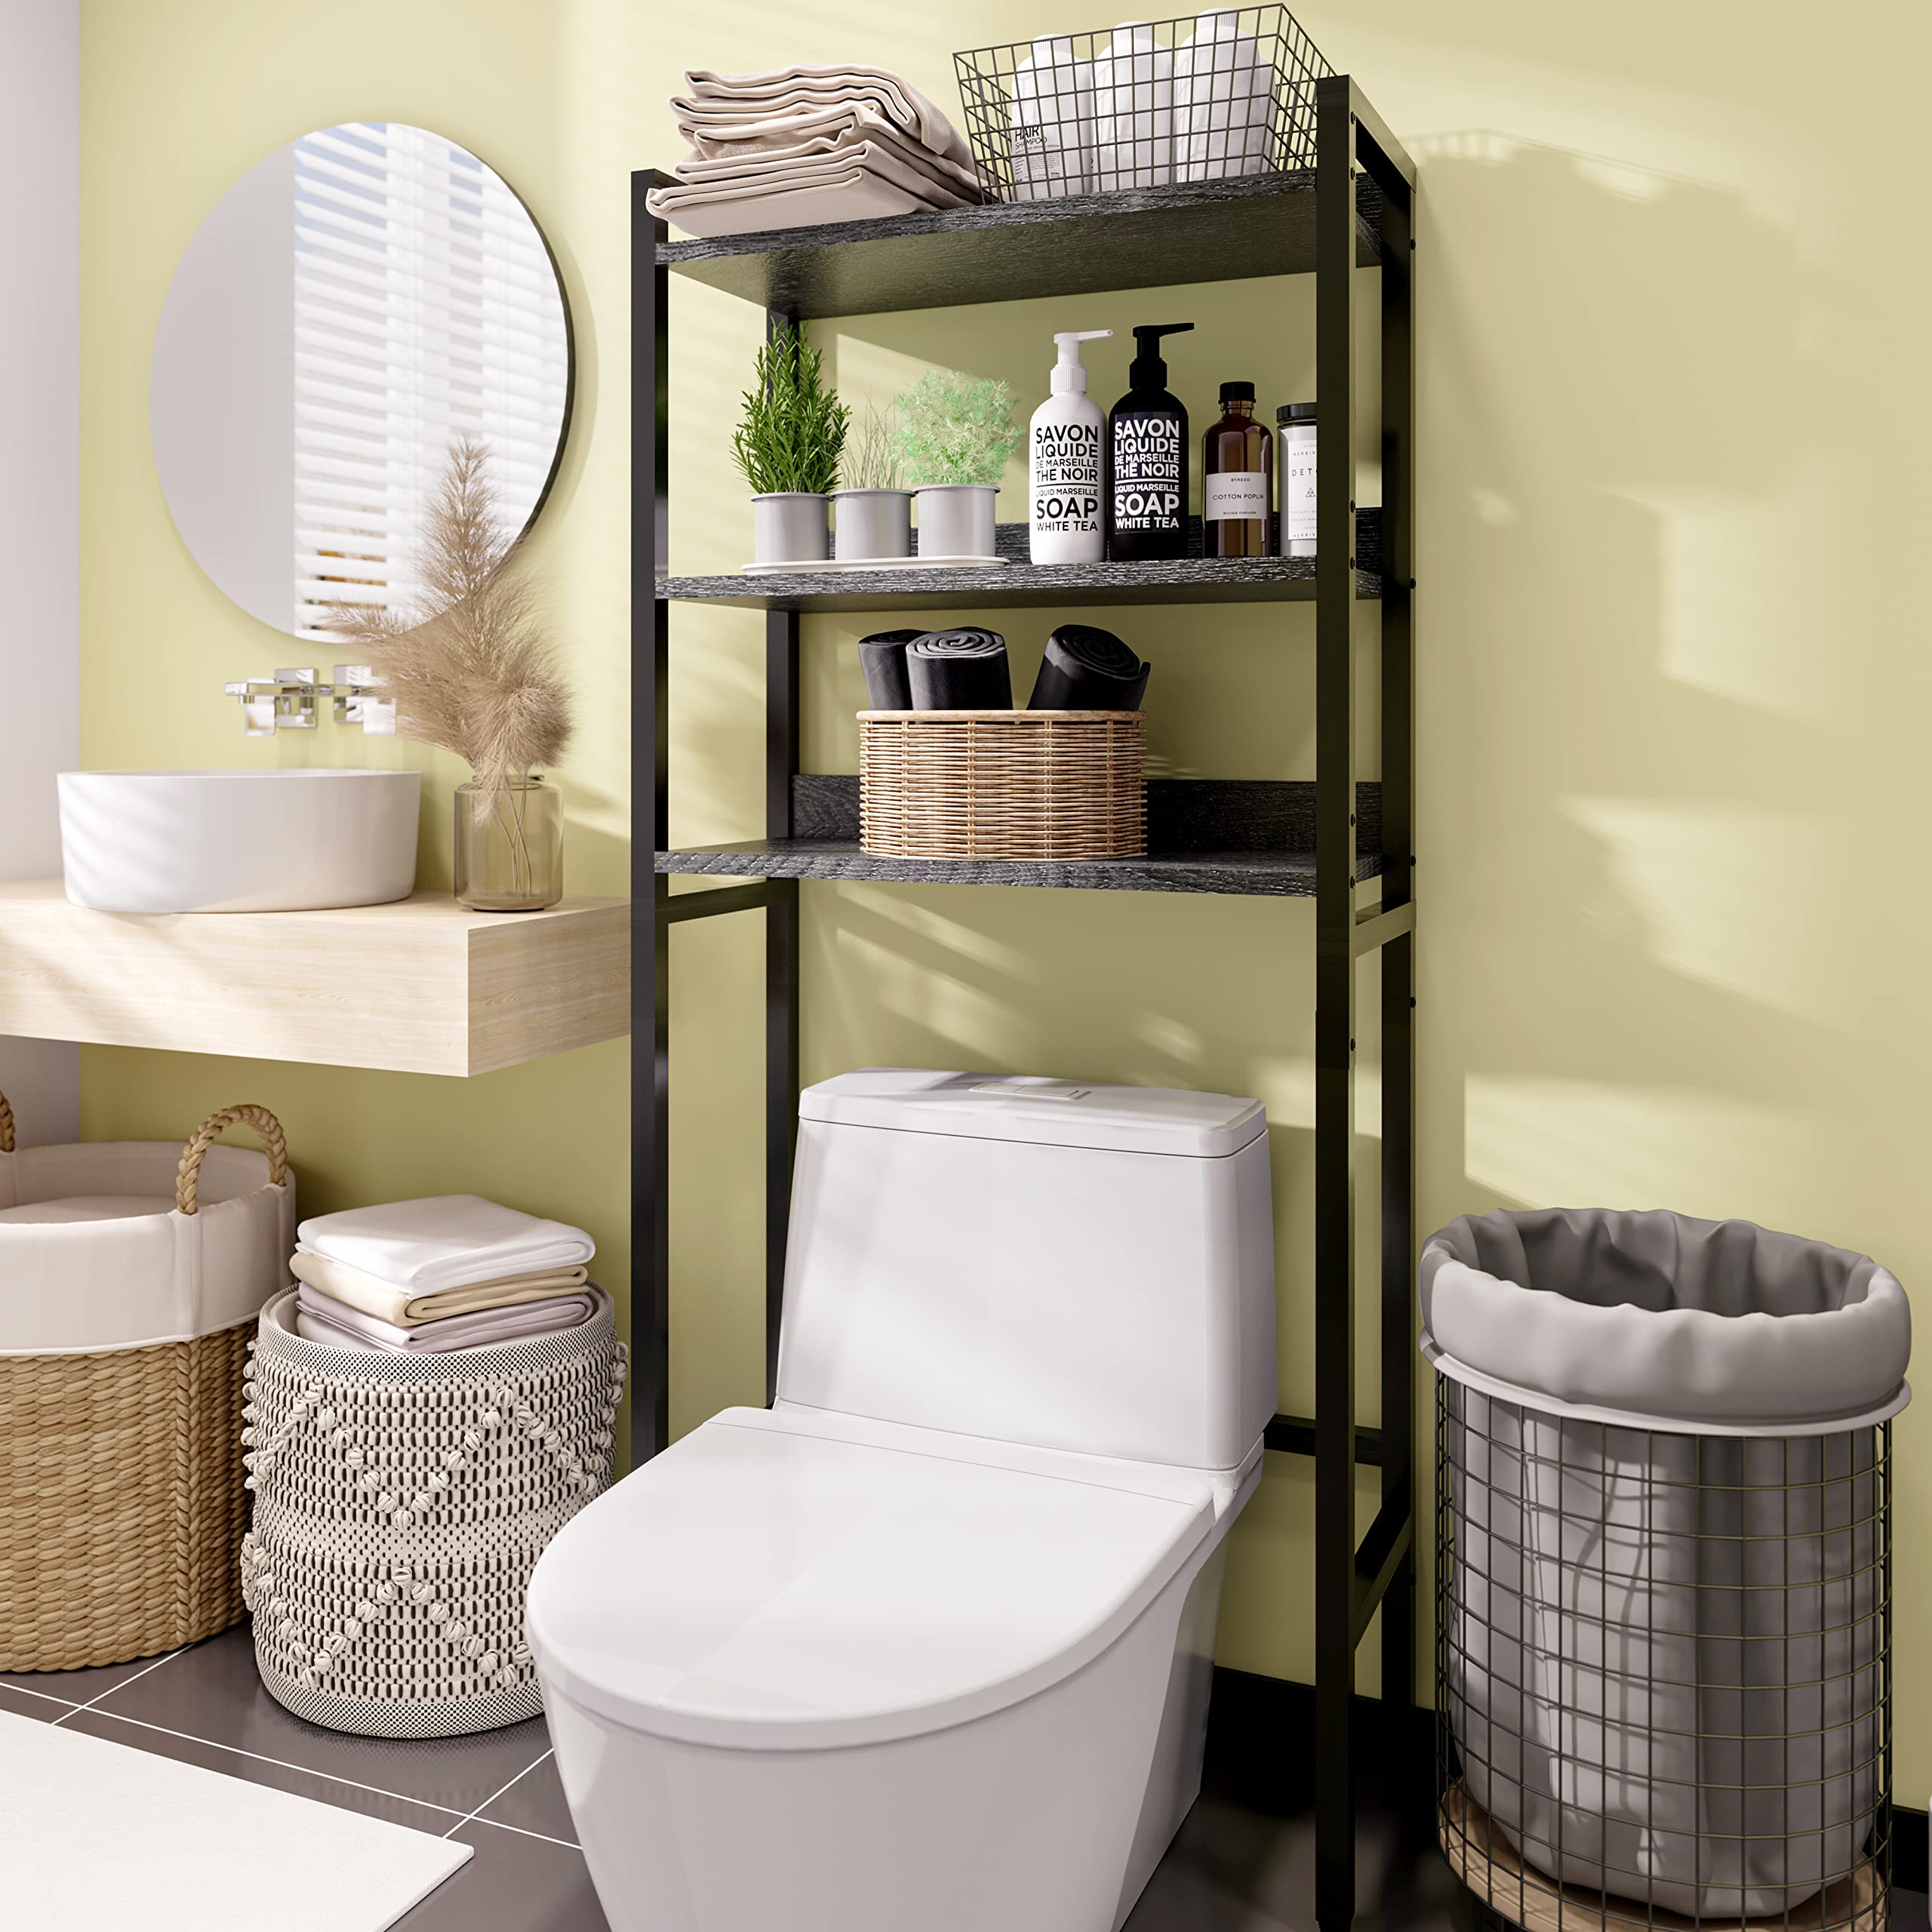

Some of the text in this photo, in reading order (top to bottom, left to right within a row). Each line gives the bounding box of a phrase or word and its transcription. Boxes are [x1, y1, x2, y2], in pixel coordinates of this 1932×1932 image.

[1015, 126, 1039, 142] HAIR
[1036, 424, 1098, 444] SAVON
[1115, 419, 1179, 440] SAVON
[1035, 443, 1098, 459] LIQUIDE
[1115, 438, 1179, 456] LIQUIDE
[1035, 458, 1098, 469] DE MARSEILLE
[1115, 454, 1179, 466] DE MARSEILLE
[1061, 468, 1098, 482] NOIR
[1141, 463, 1179, 478] NOIR
[1292, 468, 1317, 477] DET
[1035, 488, 1098, 497] LIQUID MARSEILLE
[1115, 484, 1179, 494] LIQUID MARSEILLE
[1036, 497, 1098, 519] SOAP
[1115, 493, 1180, 516] SOAP
[1036, 521, 1098, 532] WHITE TEA
[1115, 517, 1179, 529] WHITE TEA
